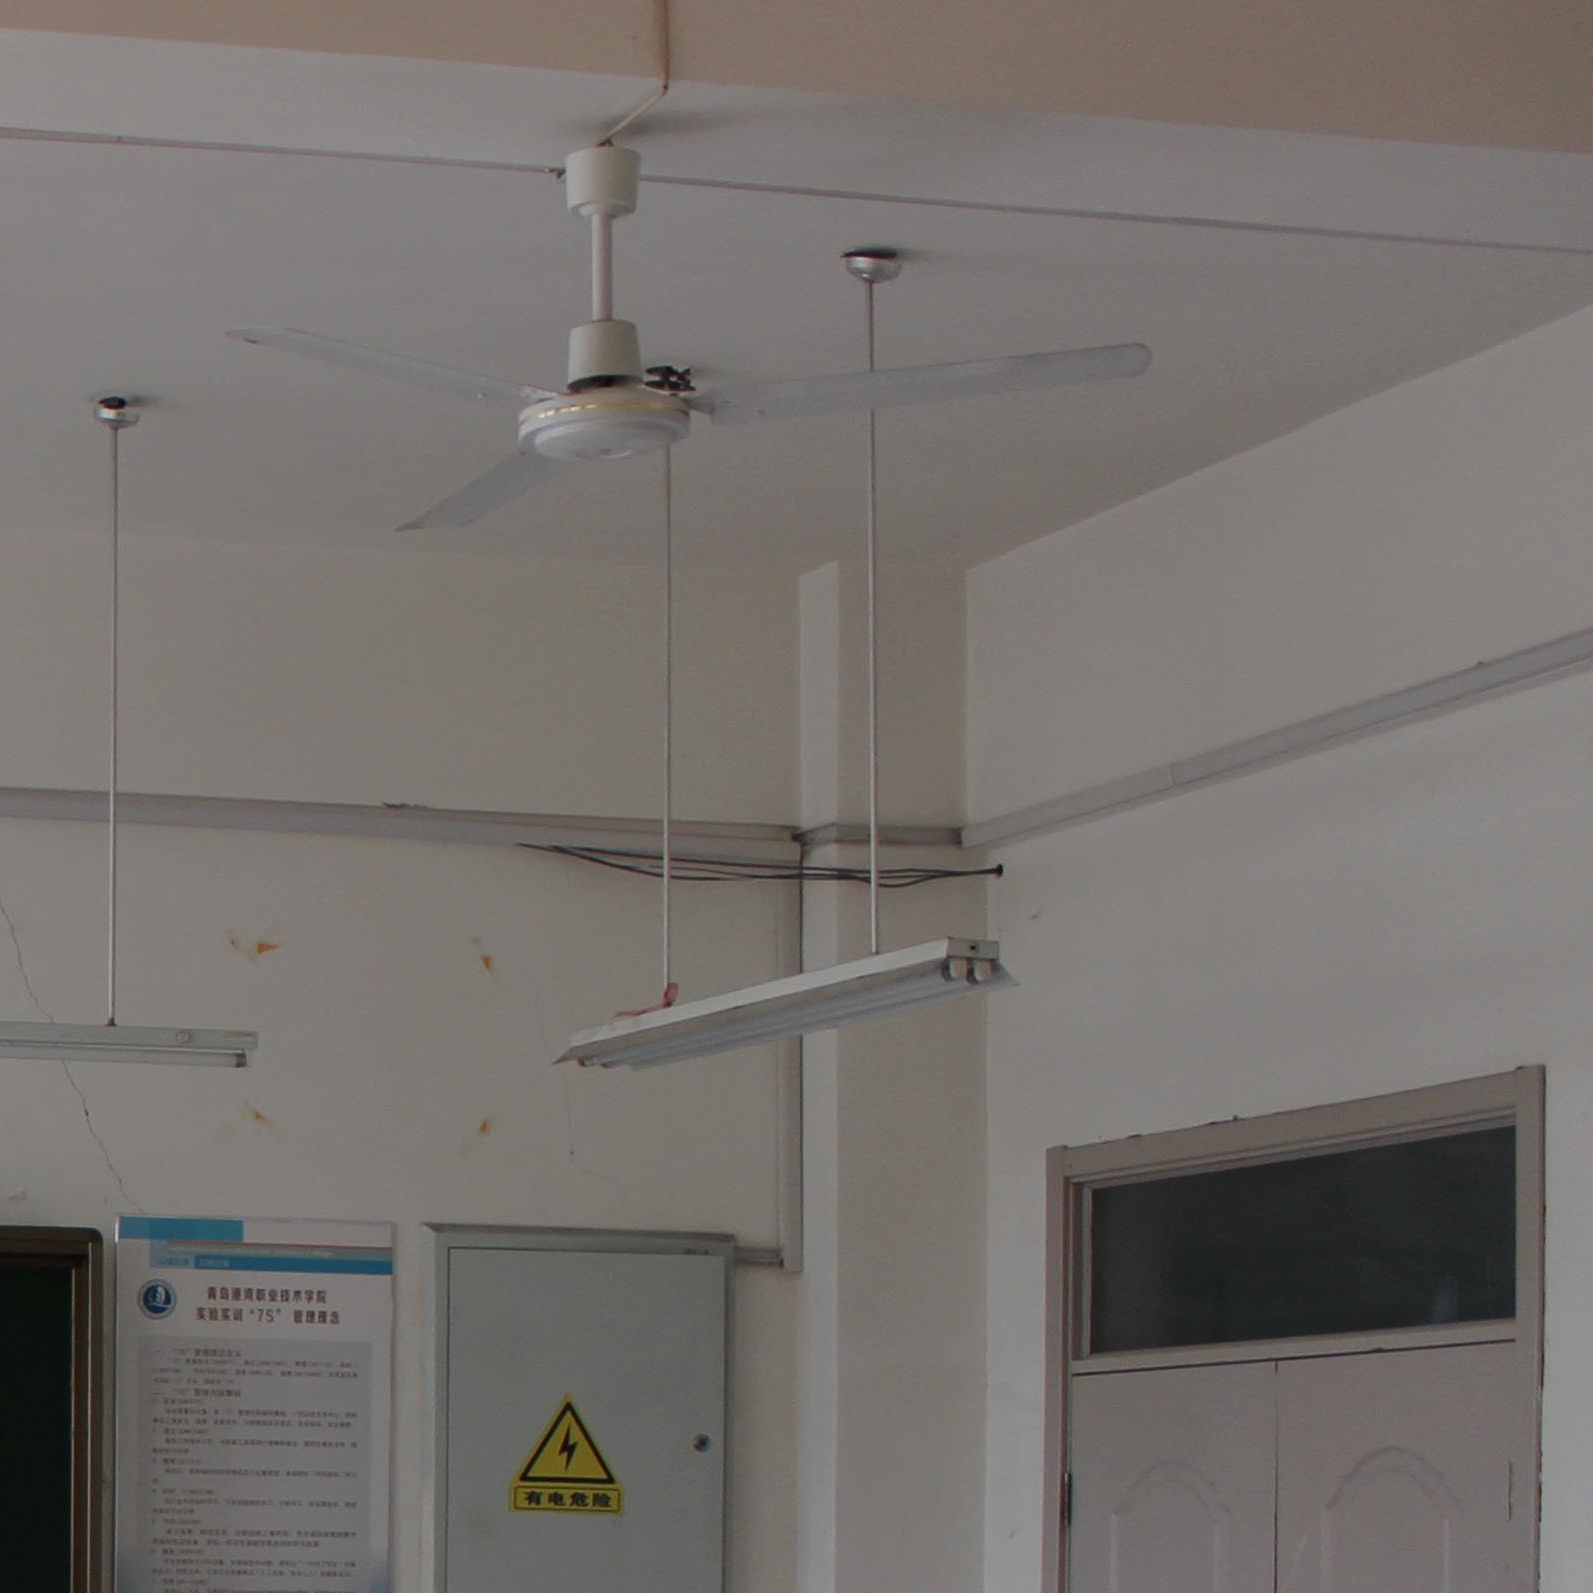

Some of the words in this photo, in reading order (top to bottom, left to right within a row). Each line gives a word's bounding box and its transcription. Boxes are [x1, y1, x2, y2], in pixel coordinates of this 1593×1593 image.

[206, 1286, 328, 1305] 青岛港湾职业技术学院
[523, 1490, 613, 1508] 有电危险
